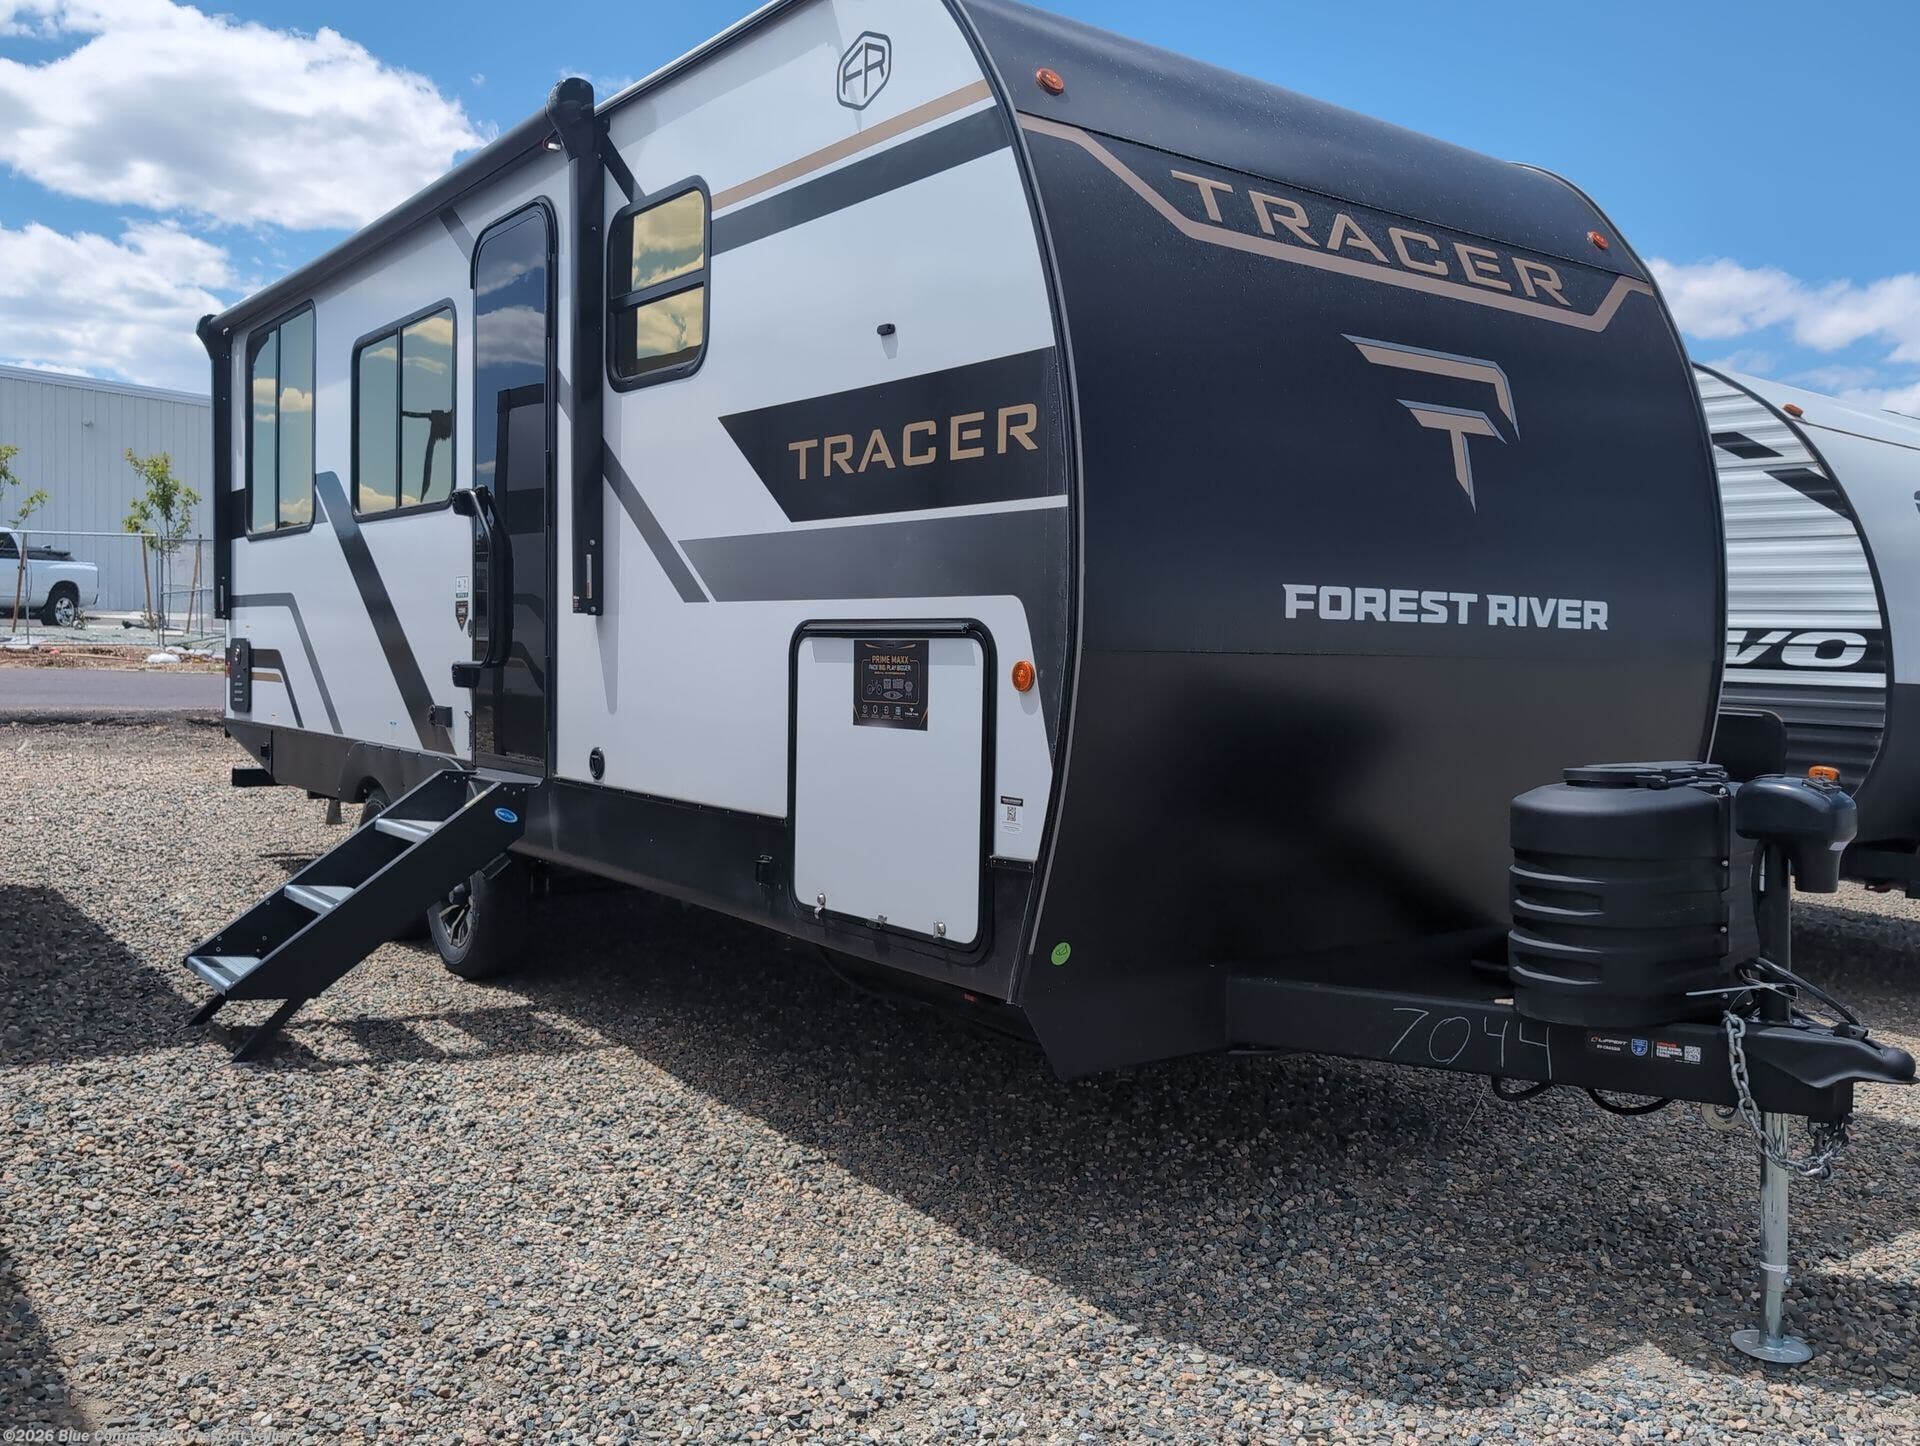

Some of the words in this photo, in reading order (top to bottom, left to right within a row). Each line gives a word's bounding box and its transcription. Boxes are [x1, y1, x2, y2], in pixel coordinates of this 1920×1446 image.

[1171, 169, 1572, 307] TRACER
[788, 403, 1039, 480] TRACER
[1282, 584, 1478, 625] FOREST
[1486, 594, 1609, 631] RIVER
[871, 655, 890, 664] PRIME
[891, 655, 909, 664] MAXX
[1389, 1008, 1552, 1080] 7044
